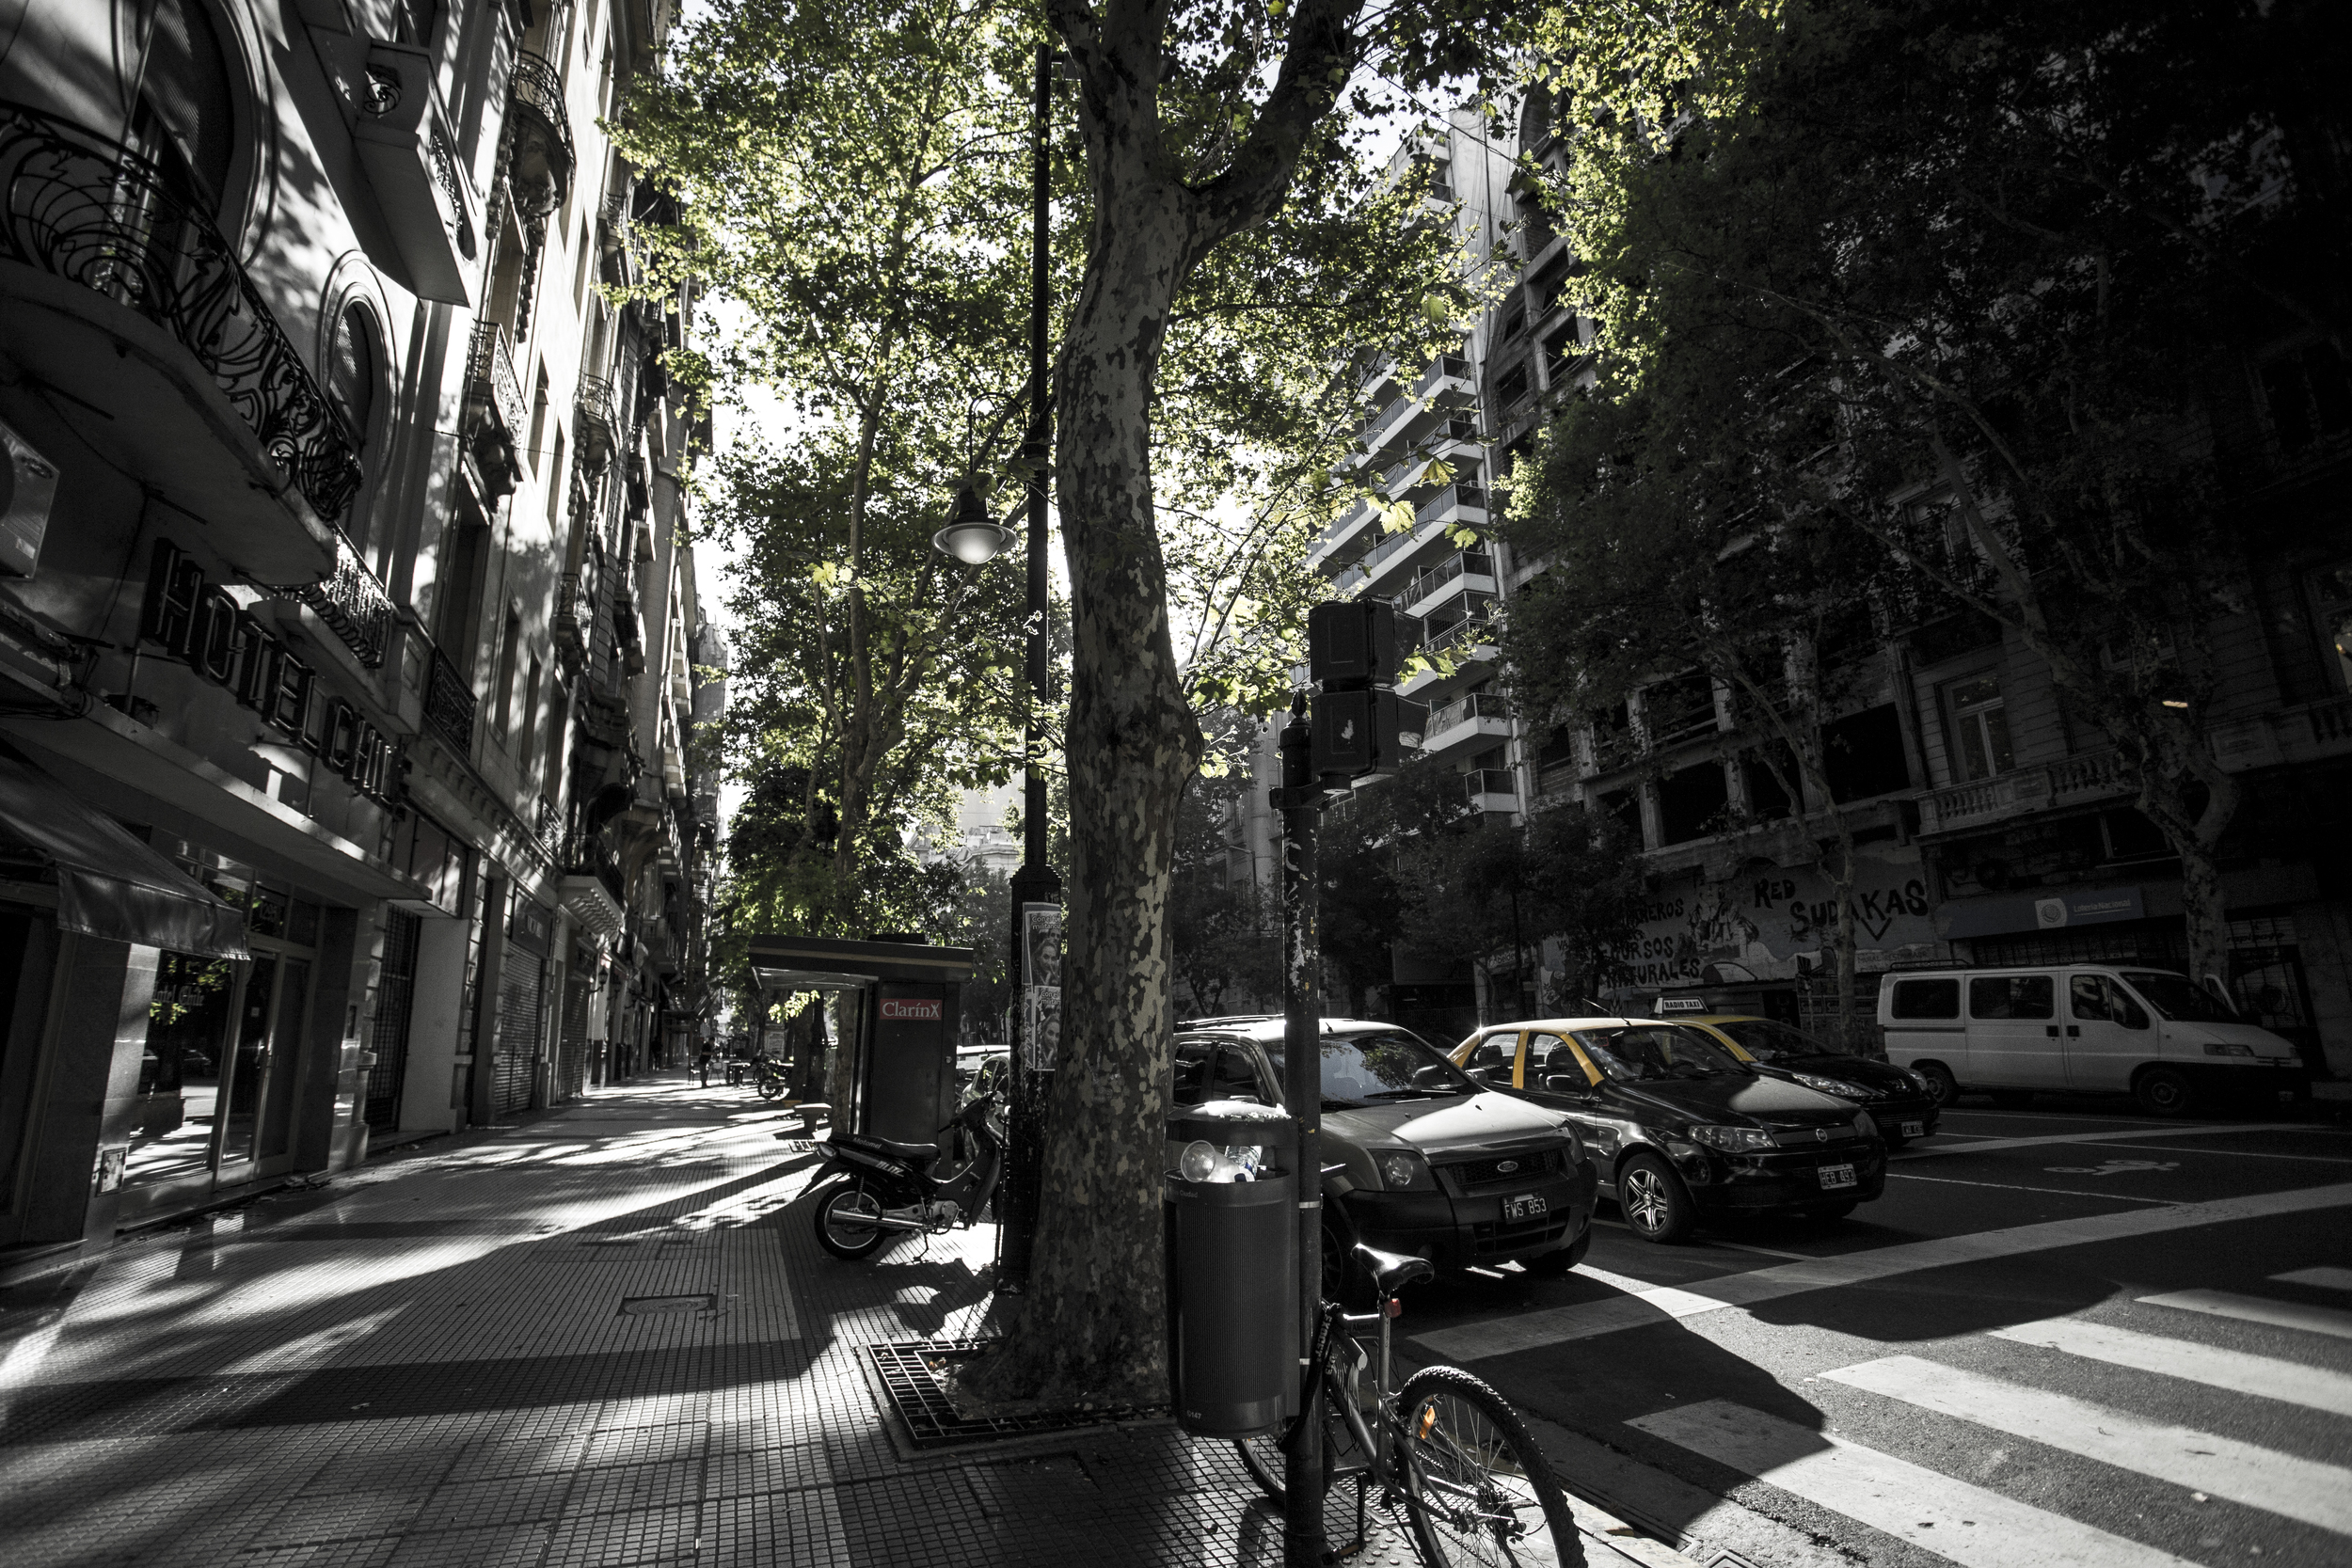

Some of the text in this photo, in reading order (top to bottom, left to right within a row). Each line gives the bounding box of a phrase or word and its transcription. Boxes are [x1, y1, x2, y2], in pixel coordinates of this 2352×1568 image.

[141, 536, 412, 822] HOTEL CHILE
[1755, 879, 1796, 910] RED
[882, 1001, 930, 1018] Clarín
[853, 1136, 882, 1149] Motomel
[1504, 1197, 1548, 1220] FWS 853
[1352, 1323, 1374, 1333] Alpina
